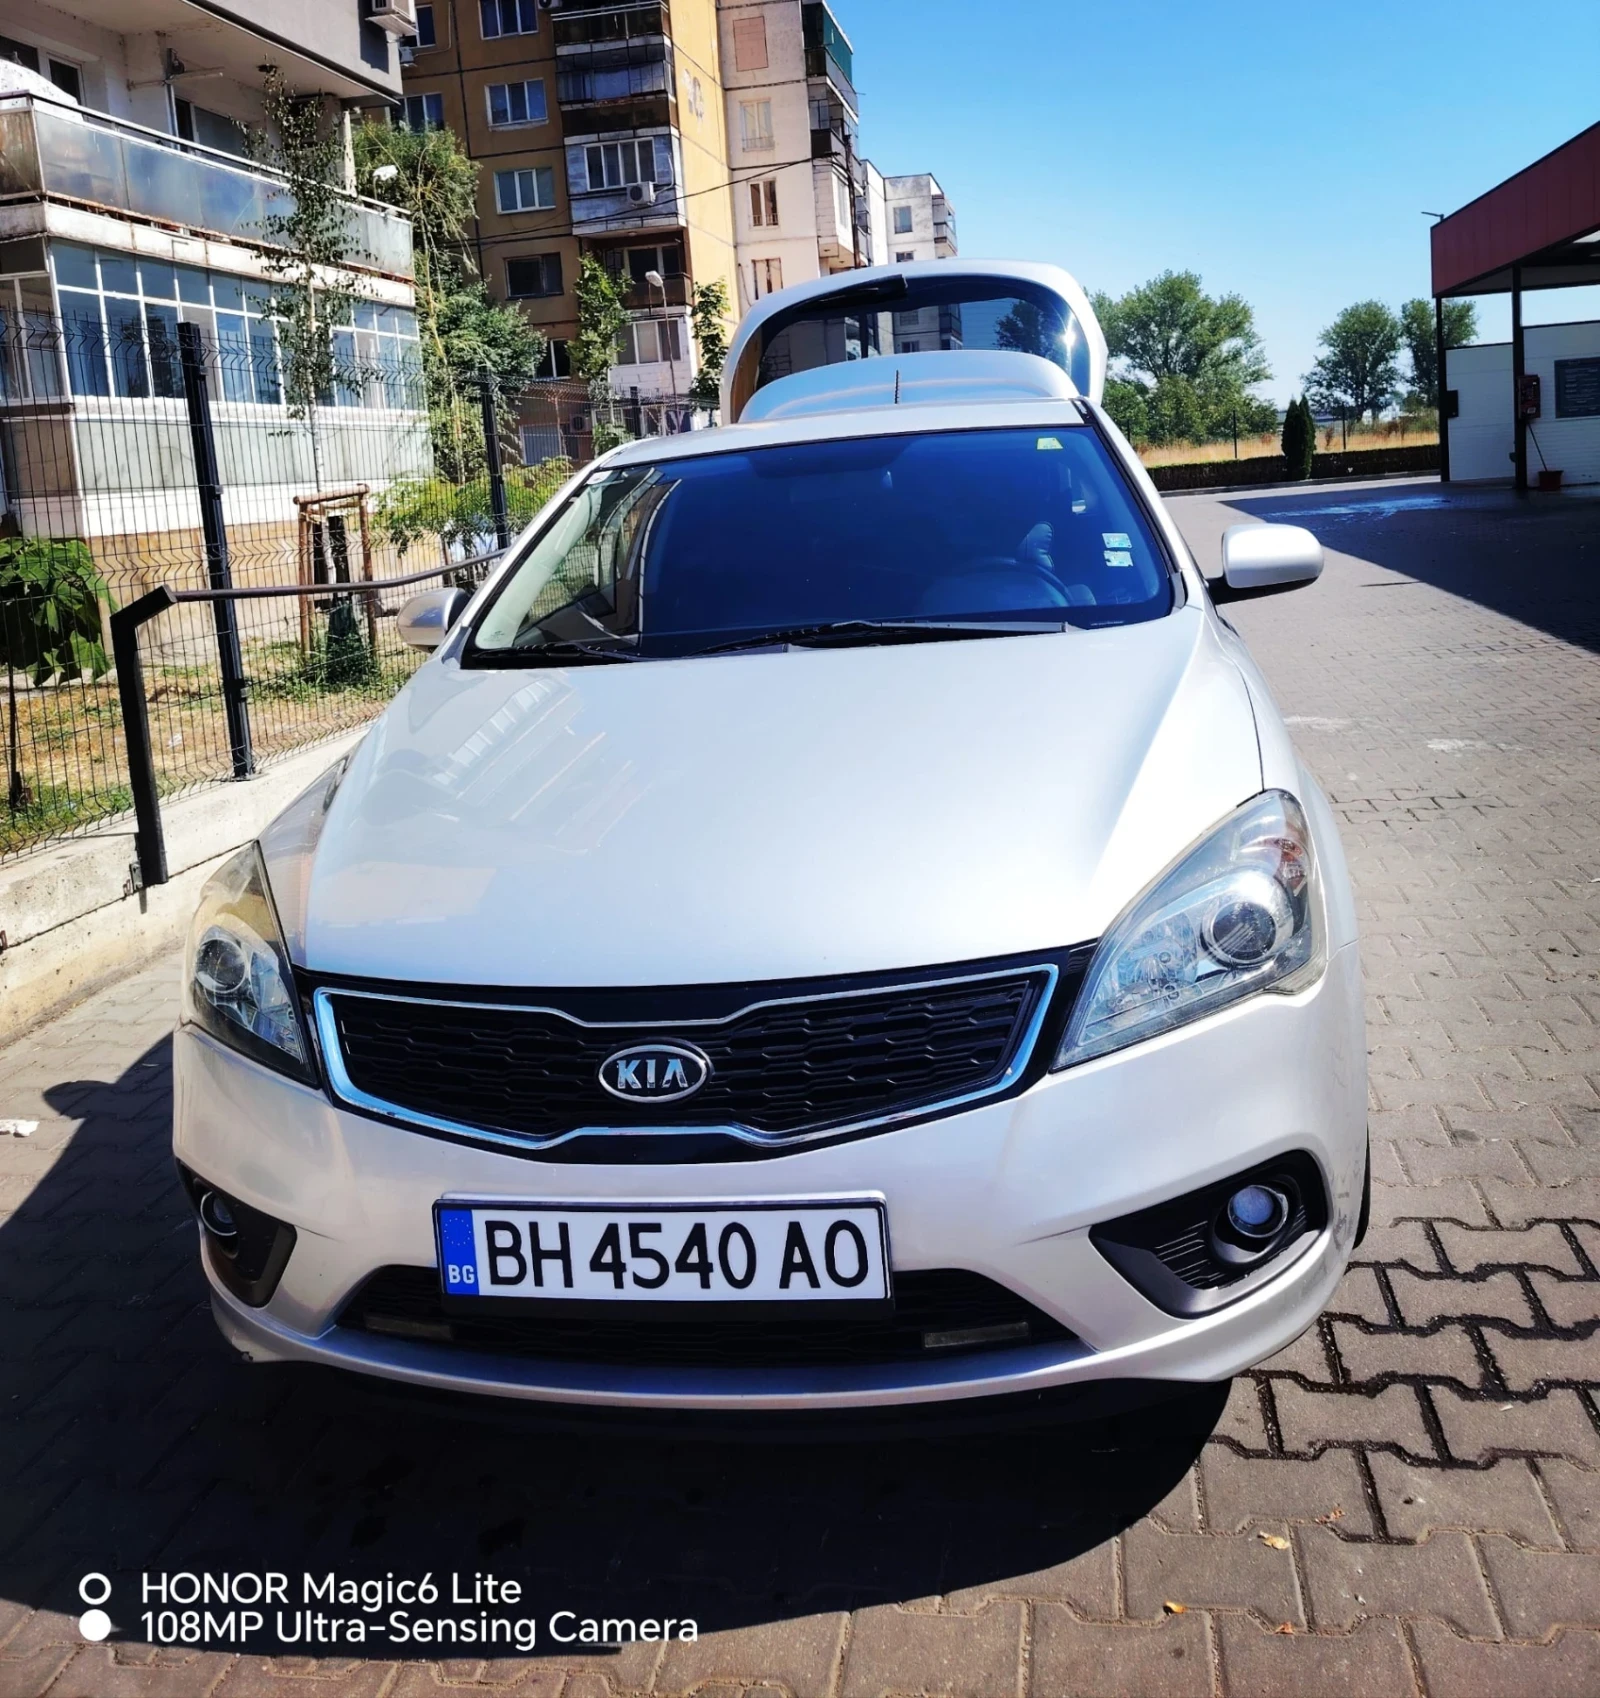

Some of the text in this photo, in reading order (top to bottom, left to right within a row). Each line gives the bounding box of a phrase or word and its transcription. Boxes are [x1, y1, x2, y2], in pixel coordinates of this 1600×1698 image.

[616, 1058, 690, 1089] KIA
[484, 1219, 869, 1290] BH 4540 AO
[447, 1264, 475, 1284] BG
